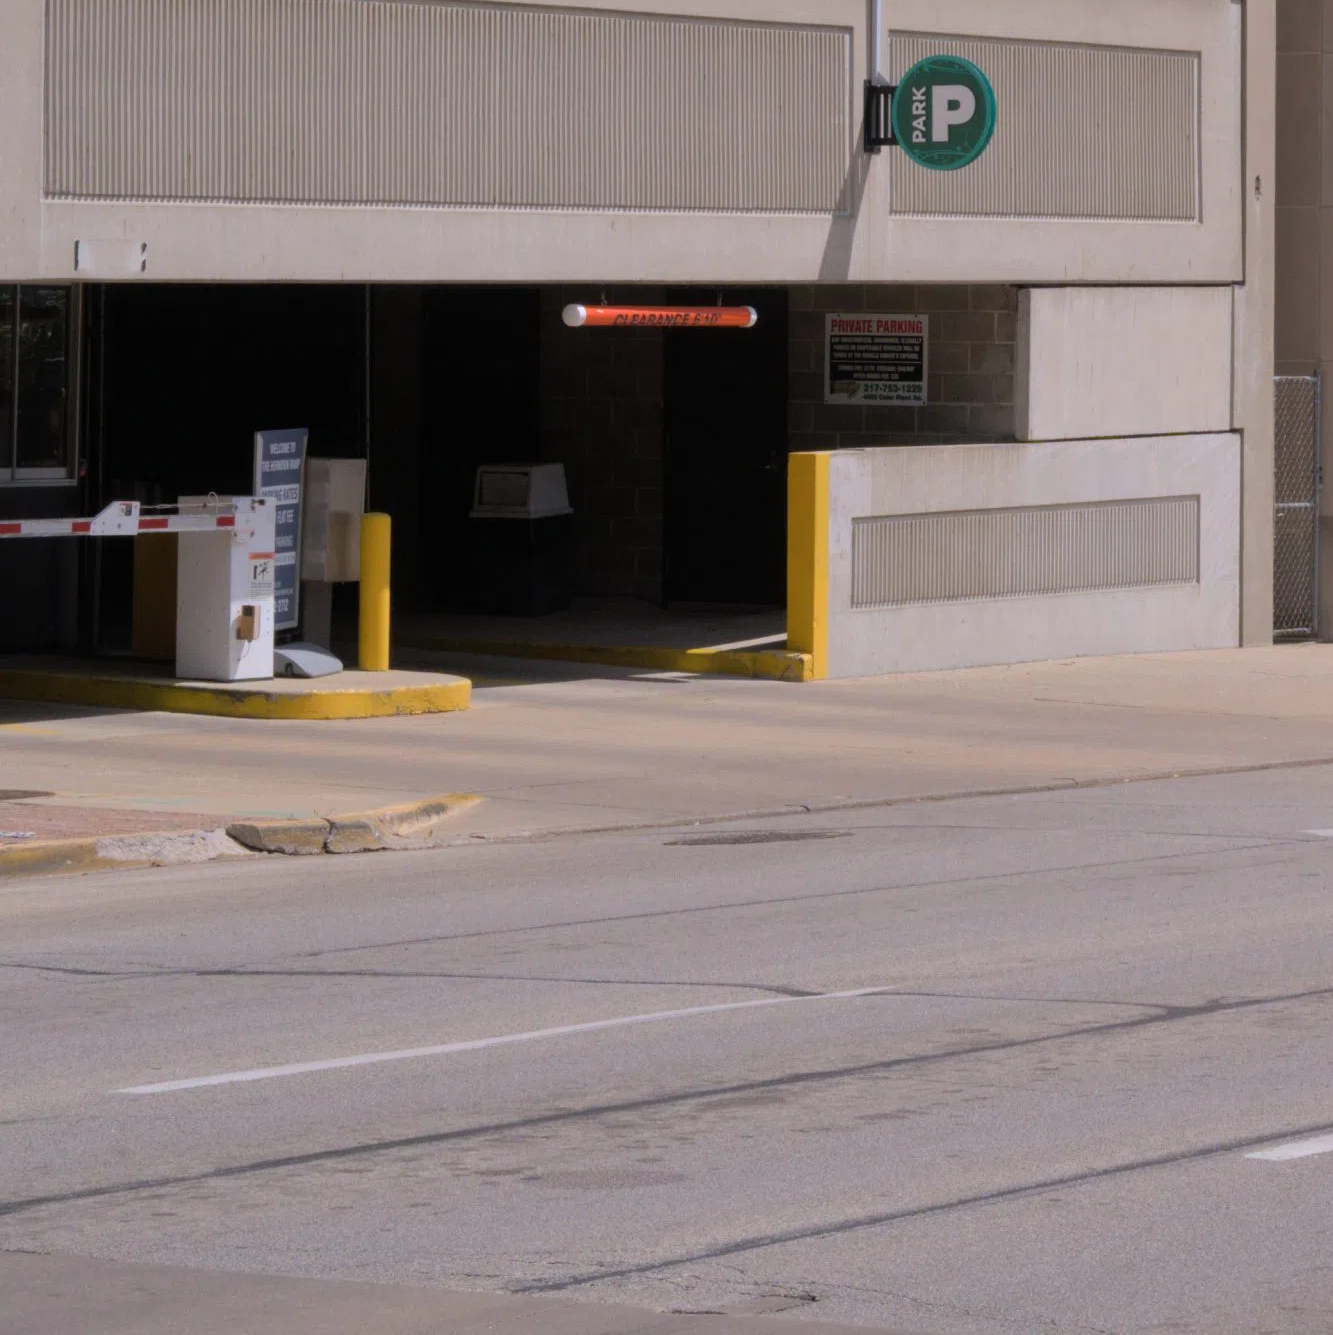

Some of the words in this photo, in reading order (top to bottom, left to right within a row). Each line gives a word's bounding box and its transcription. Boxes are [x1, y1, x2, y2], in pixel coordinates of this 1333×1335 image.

[912, 85, 926, 143] PARK
[932, 85, 976, 142] P
[613, 313, 690, 326] CLEARANCE
[831, 319, 873, 333] PRIVATE
[876, 320, 923, 334] PARKING
